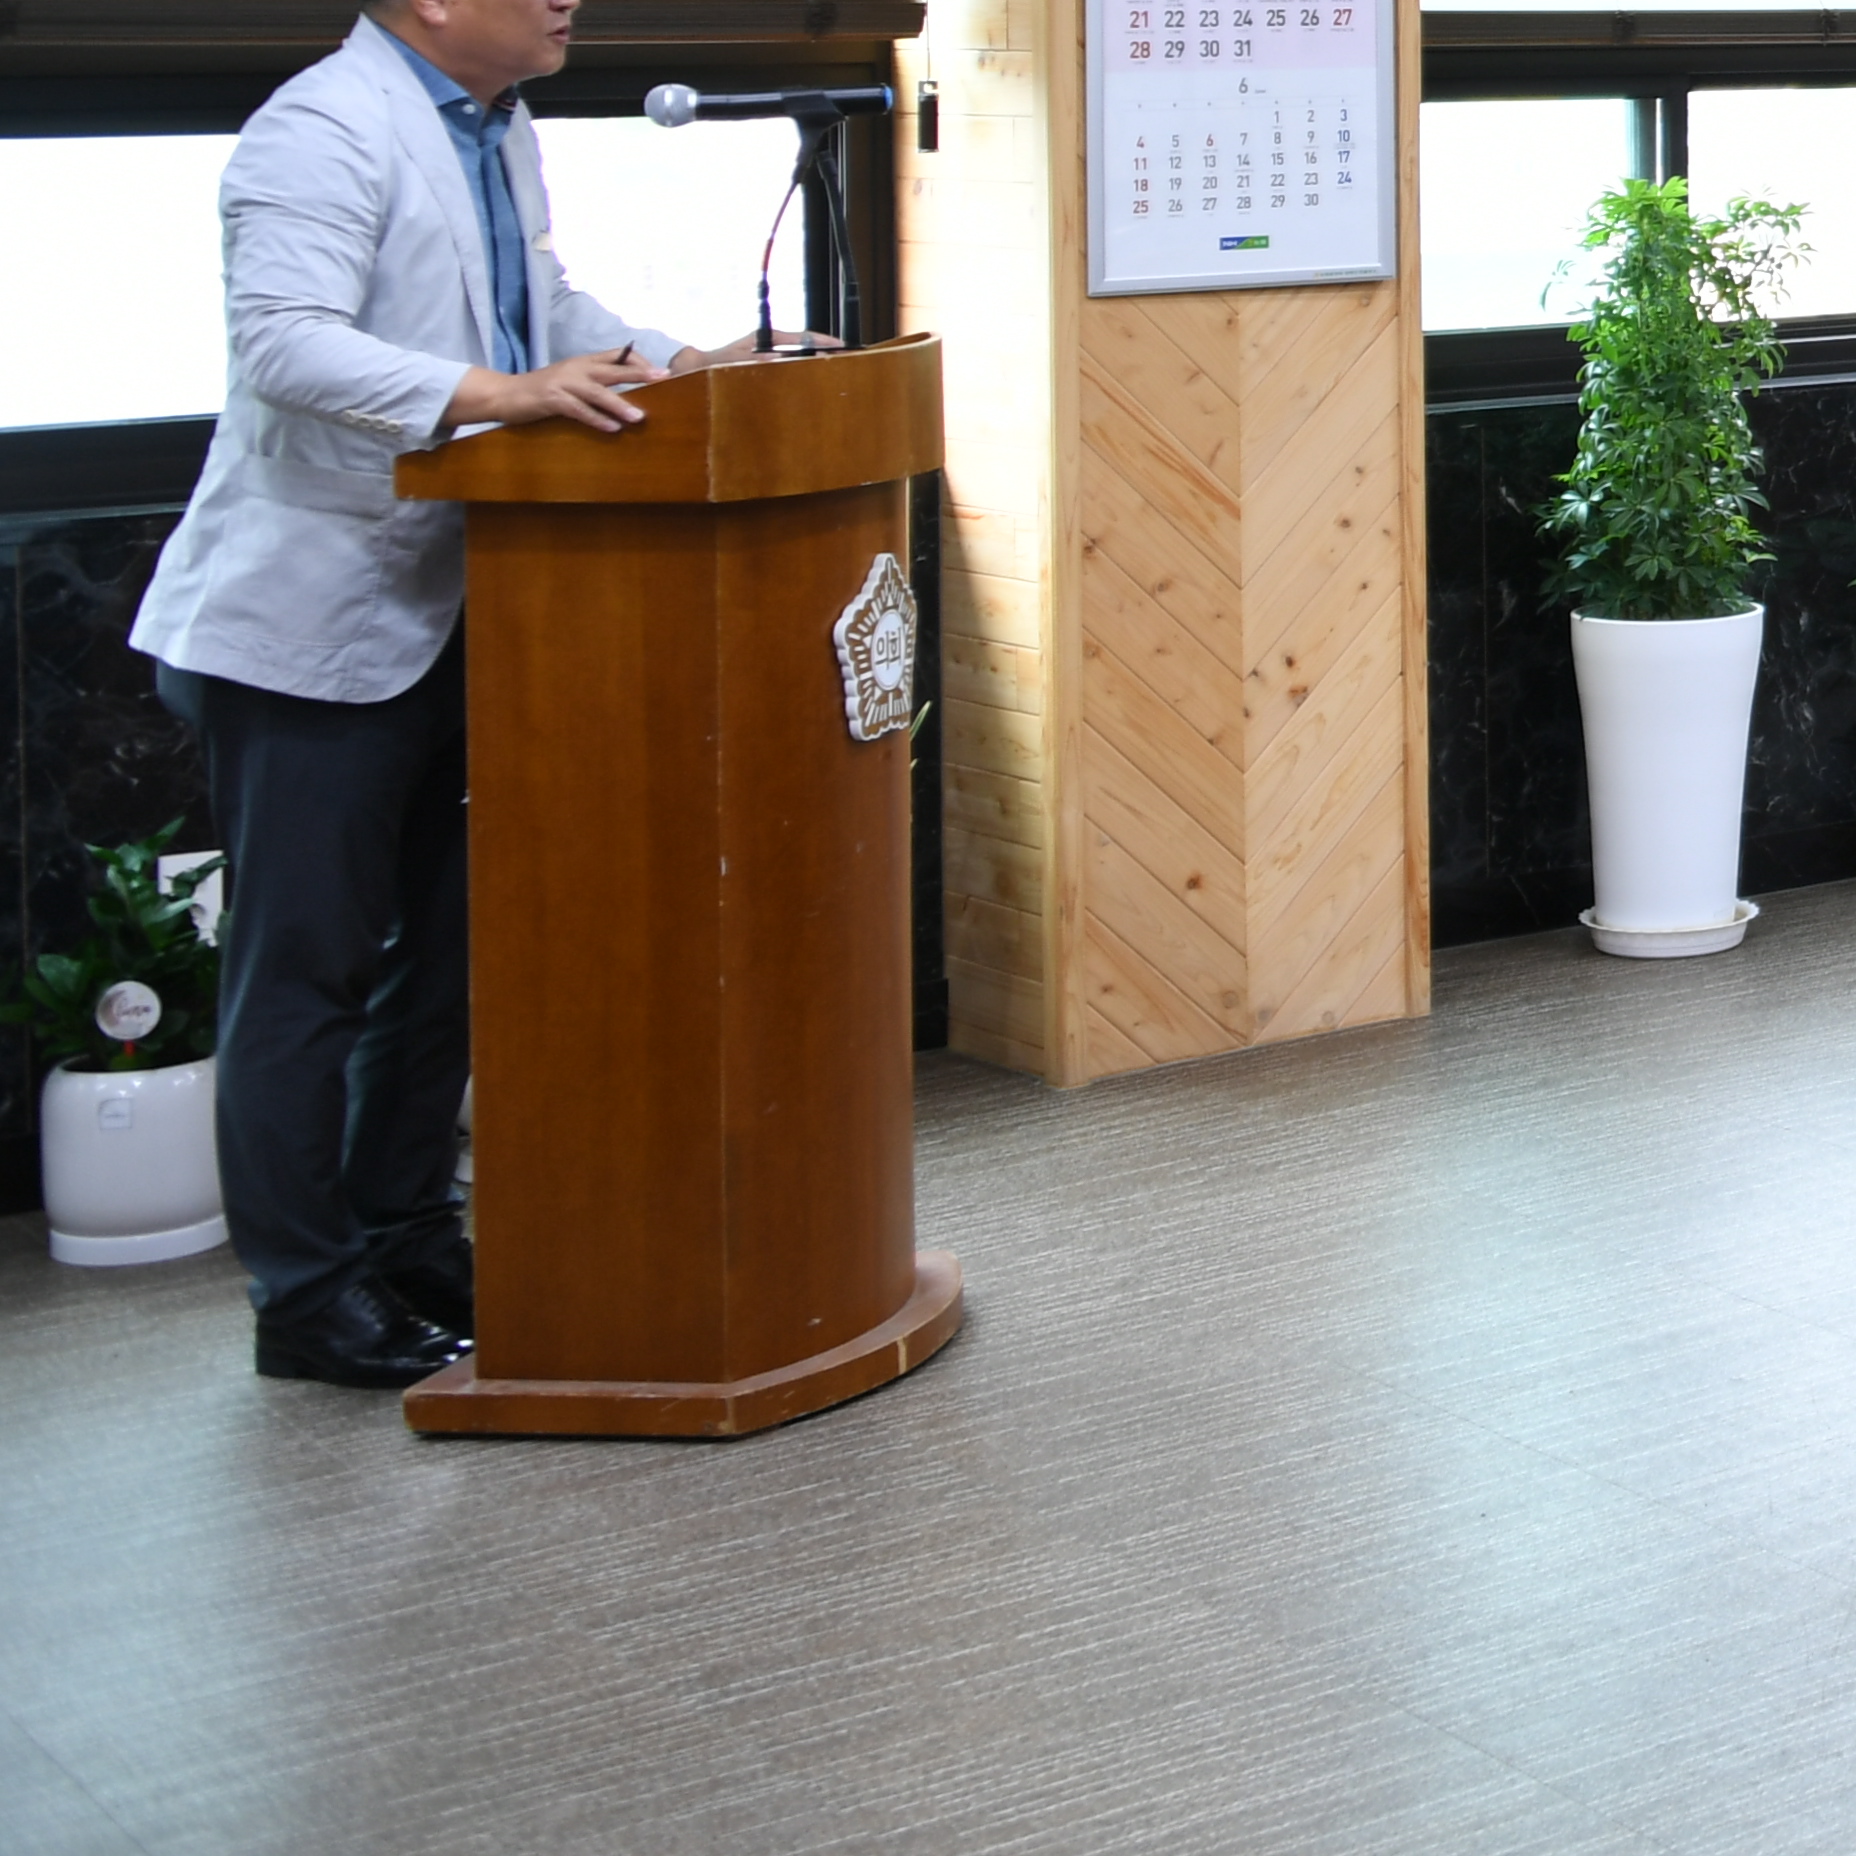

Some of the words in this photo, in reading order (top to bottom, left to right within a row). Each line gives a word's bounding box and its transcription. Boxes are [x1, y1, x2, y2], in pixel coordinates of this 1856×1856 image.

[1130, 10, 1148, 28] 21
[1164, 10, 1185, 28] 22
[1199, 10, 1219, 27] 23
[1233, 10, 1253, 27] 24
[1266, 9, 1286, 27] 25
[1300, 9, 1320, 26] 26
[1333, 8, 1352, 26] 27
[1130, 41, 1151, 59] 28
[1164, 40, 1185, 58] 29
[1200, 40, 1220, 57] 30
[1234, 39, 1251, 57] 31
[1239, 77, 1248, 94] 6
[1274, 110, 1279, 124] 1
[1307, 110, 1315, 123] 2
[1340, 109, 1347, 122] 3
[1136, 136, 1145, 148] 4
[1172, 134, 1179, 148] 5
[1206, 134, 1214, 147] 6
[1240, 132, 1248, 146] 7
[1274, 131, 1282, 144] 8
[1307, 130, 1315, 143] 9
[1338, 129, 1350, 142] 10
[1134, 157, 1147, 171] 11
[1169, 156, 1182, 169] 12
[1203, 155, 1216, 168] 13
[1237, 154, 1250, 166] 14
[1271, 152, 1284, 165] 15
[1304, 151, 1317, 164] 16
[1338, 150, 1350, 163] 17
[1134, 179, 1148, 192] 18
[1169, 177, 1182, 190] 19
[1202, 176, 1218, 189] 20
[1237, 175, 1250, 188] 21
[1270, 173, 1285, 187] 22
[1304, 172, 1319, 186] 23
[1337, 171, 1352, 184] 24
[1133, 200, 1149, 214] 25
[1168, 199, 1183, 212] 26
[1202, 197, 1217, 211] 27
[1237, 196, 1251, 209] 28
[1271, 194, 1285, 208] 29
[1304, 193, 1319, 206] 30
[875, 625, 902, 671] 의회
